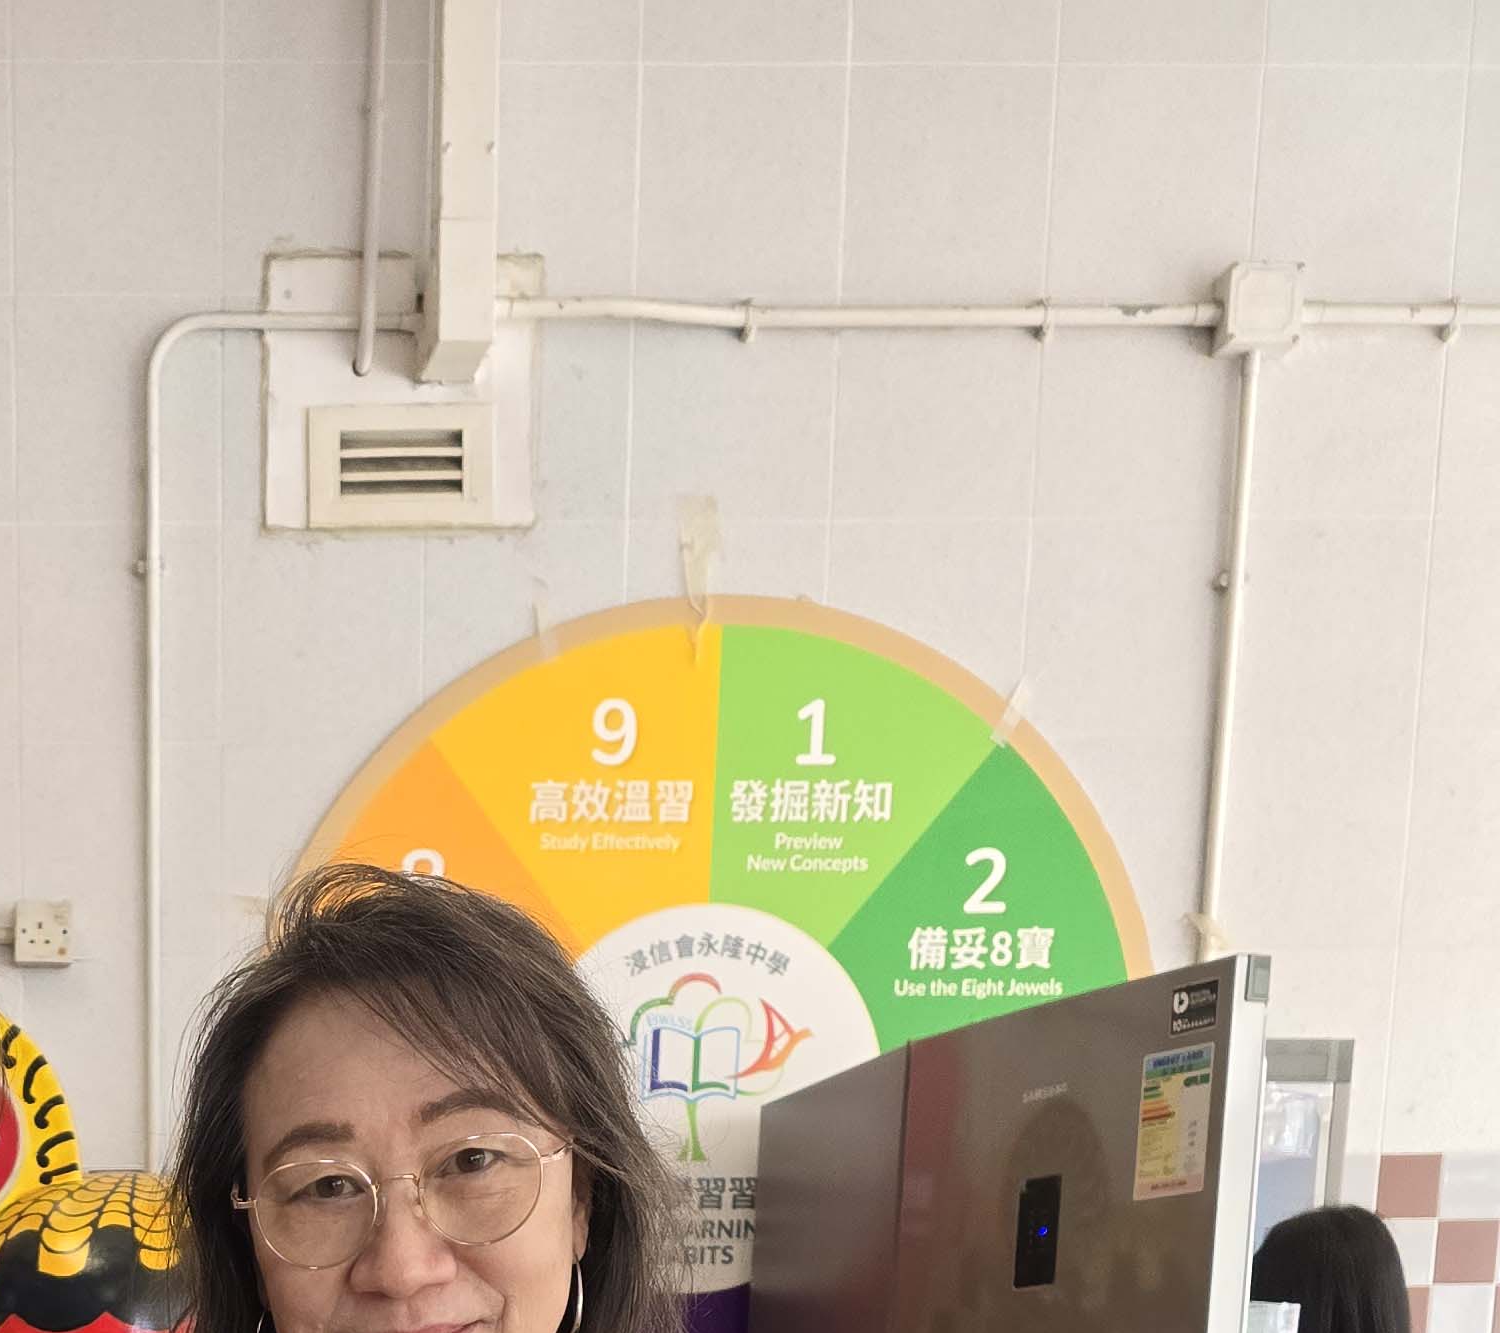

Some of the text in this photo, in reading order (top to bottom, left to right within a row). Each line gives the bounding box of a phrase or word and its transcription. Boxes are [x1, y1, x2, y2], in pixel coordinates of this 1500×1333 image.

[591, 698, 638, 766] 9
[795, 698, 837, 766] 1
[529, 780, 693, 824] 高效溫習
[730, 778, 893, 824] 發掘新知
[540, 832, 681, 853] Study Effectively
[746, 854, 869, 874] New Concepts
[775, 833, 843, 850] Preview
[962, 847, 1008, 915] 2
[624, 932, 791, 977] 浸信會永隆中學
[908, 926, 1057, 972] 備妥8寶
[894, 978, 1064, 1001] Use the Eight Jewels
